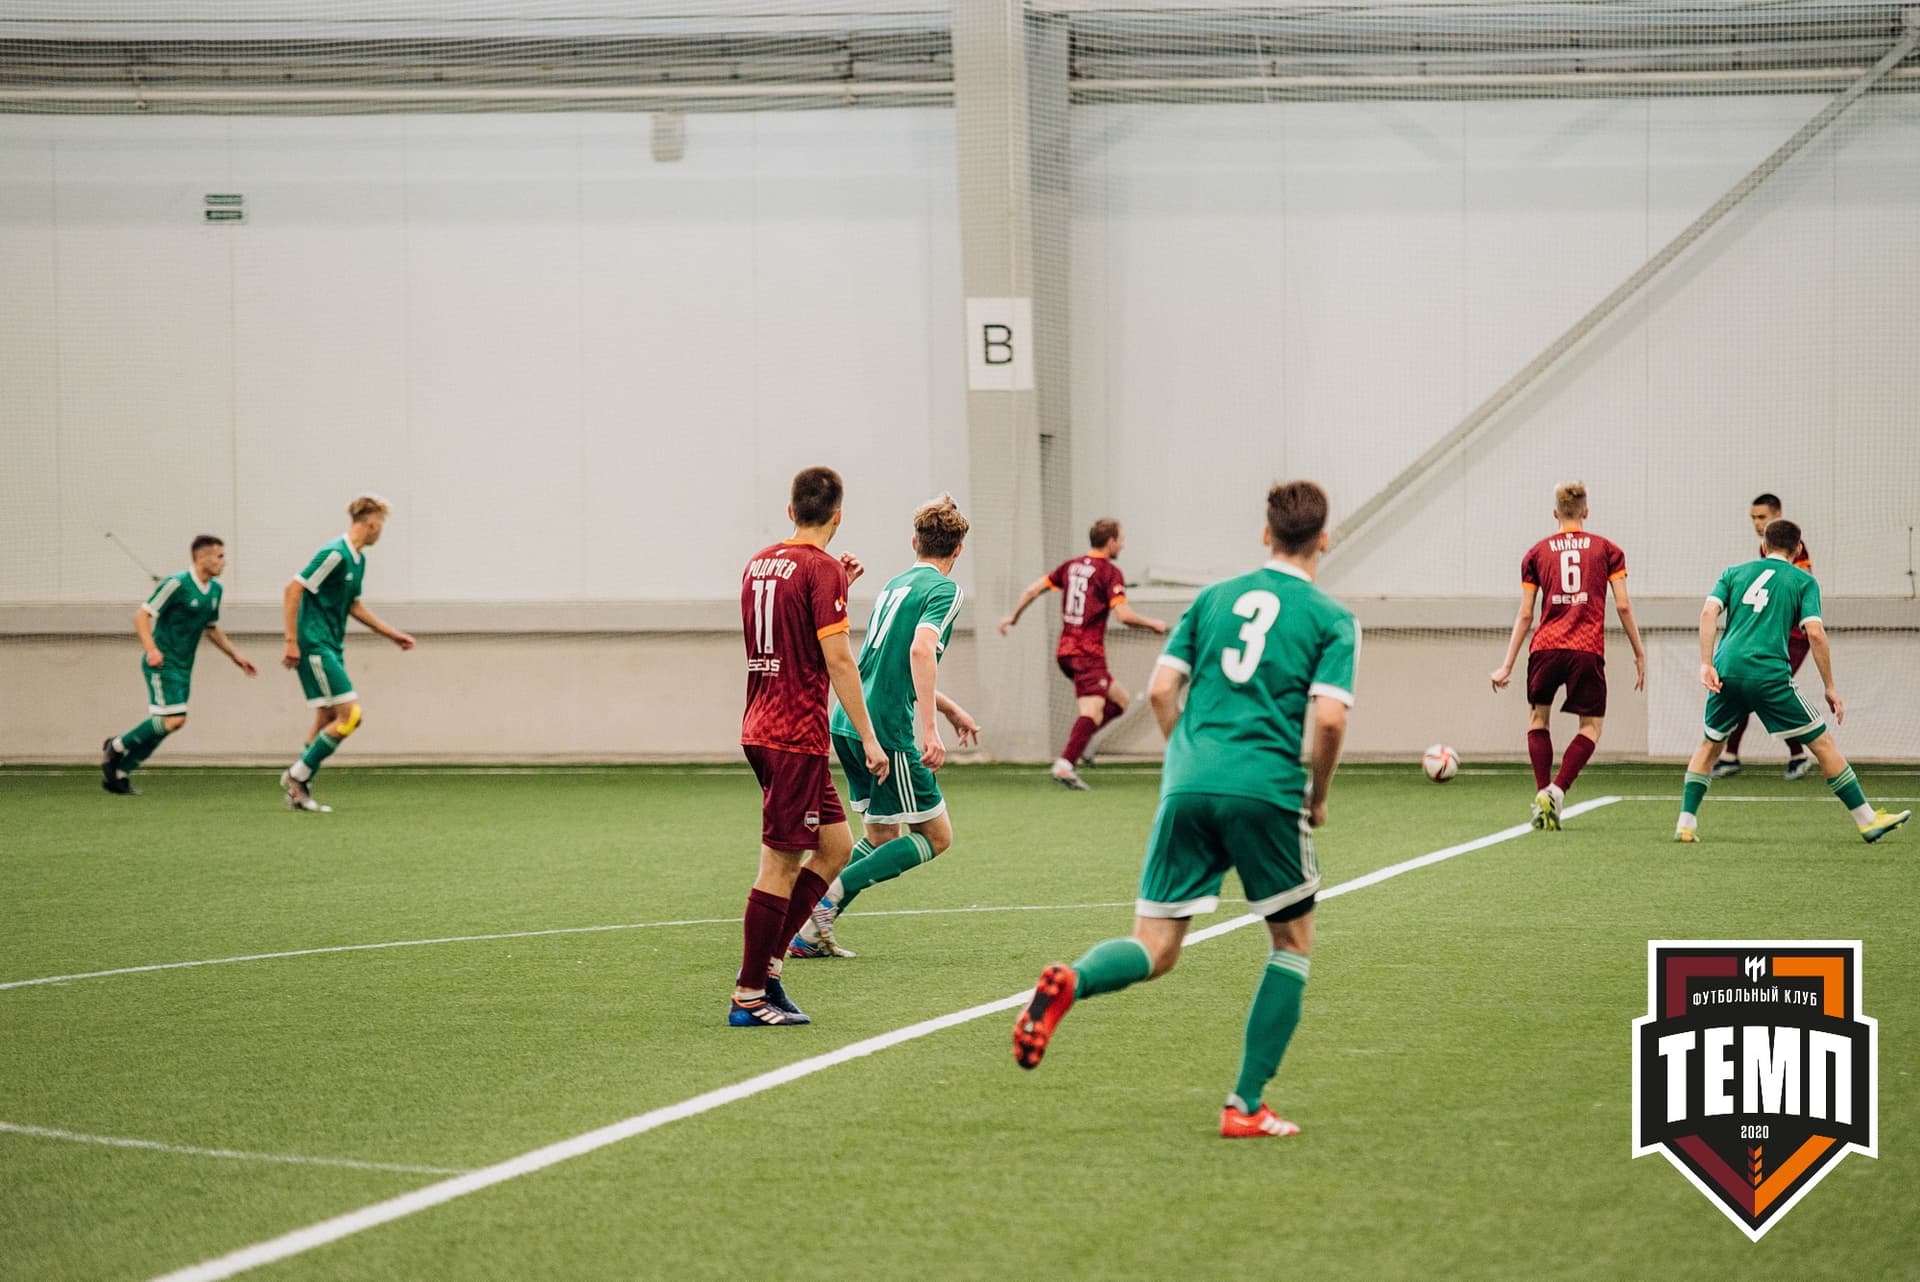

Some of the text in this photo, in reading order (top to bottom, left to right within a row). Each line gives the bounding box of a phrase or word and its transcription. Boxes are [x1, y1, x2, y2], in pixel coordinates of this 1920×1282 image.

[1560, 550, 1580, 593] 6
[1742, 569, 1776, 612] 4
[752, 580, 776, 654] 11
[867, 586, 912, 649] 17
[1221, 590, 1280, 683] 3
